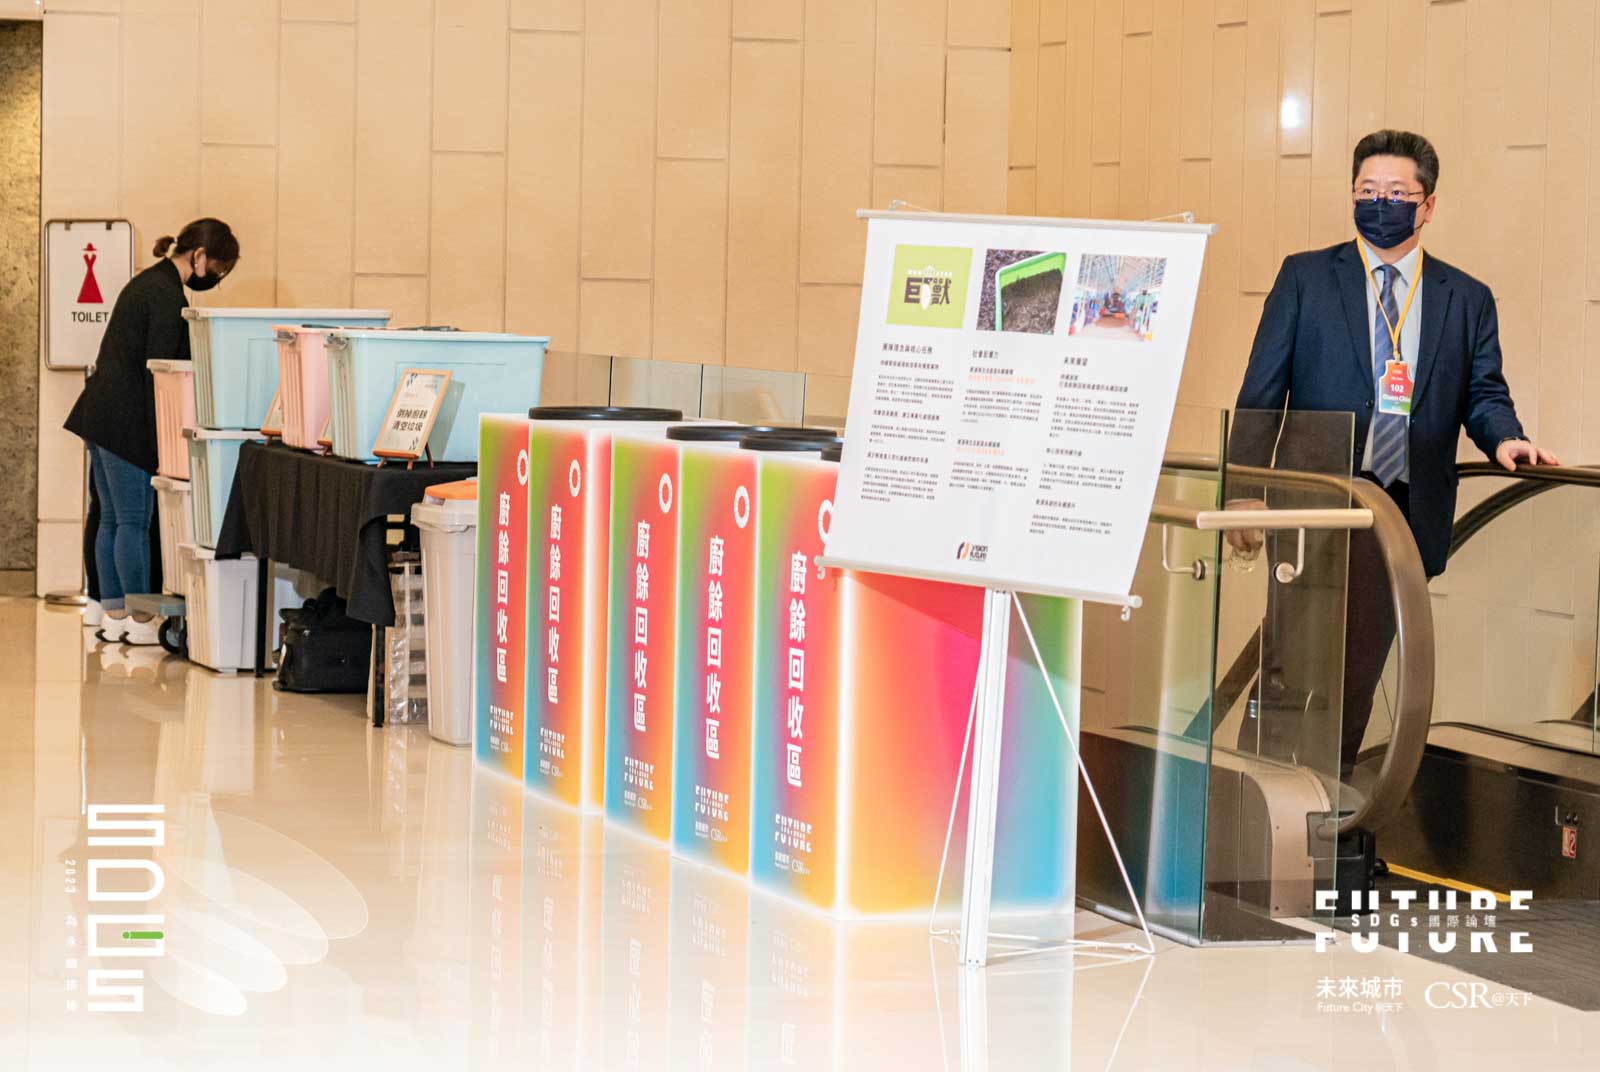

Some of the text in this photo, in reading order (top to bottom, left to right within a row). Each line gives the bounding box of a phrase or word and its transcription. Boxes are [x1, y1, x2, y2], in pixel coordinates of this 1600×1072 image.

[71, 311, 109, 323] TOILET
[1390, 383, 1404, 392] 102
[496, 491, 511, 683] 廚餘回收區
[547, 503, 562, 705] 廚餘回收區
[633, 520, 651, 733] 廚餘回收區
[705, 535, 725, 760] 廚餘回收區
[786, 550, 807, 788] 廚餘回收區
